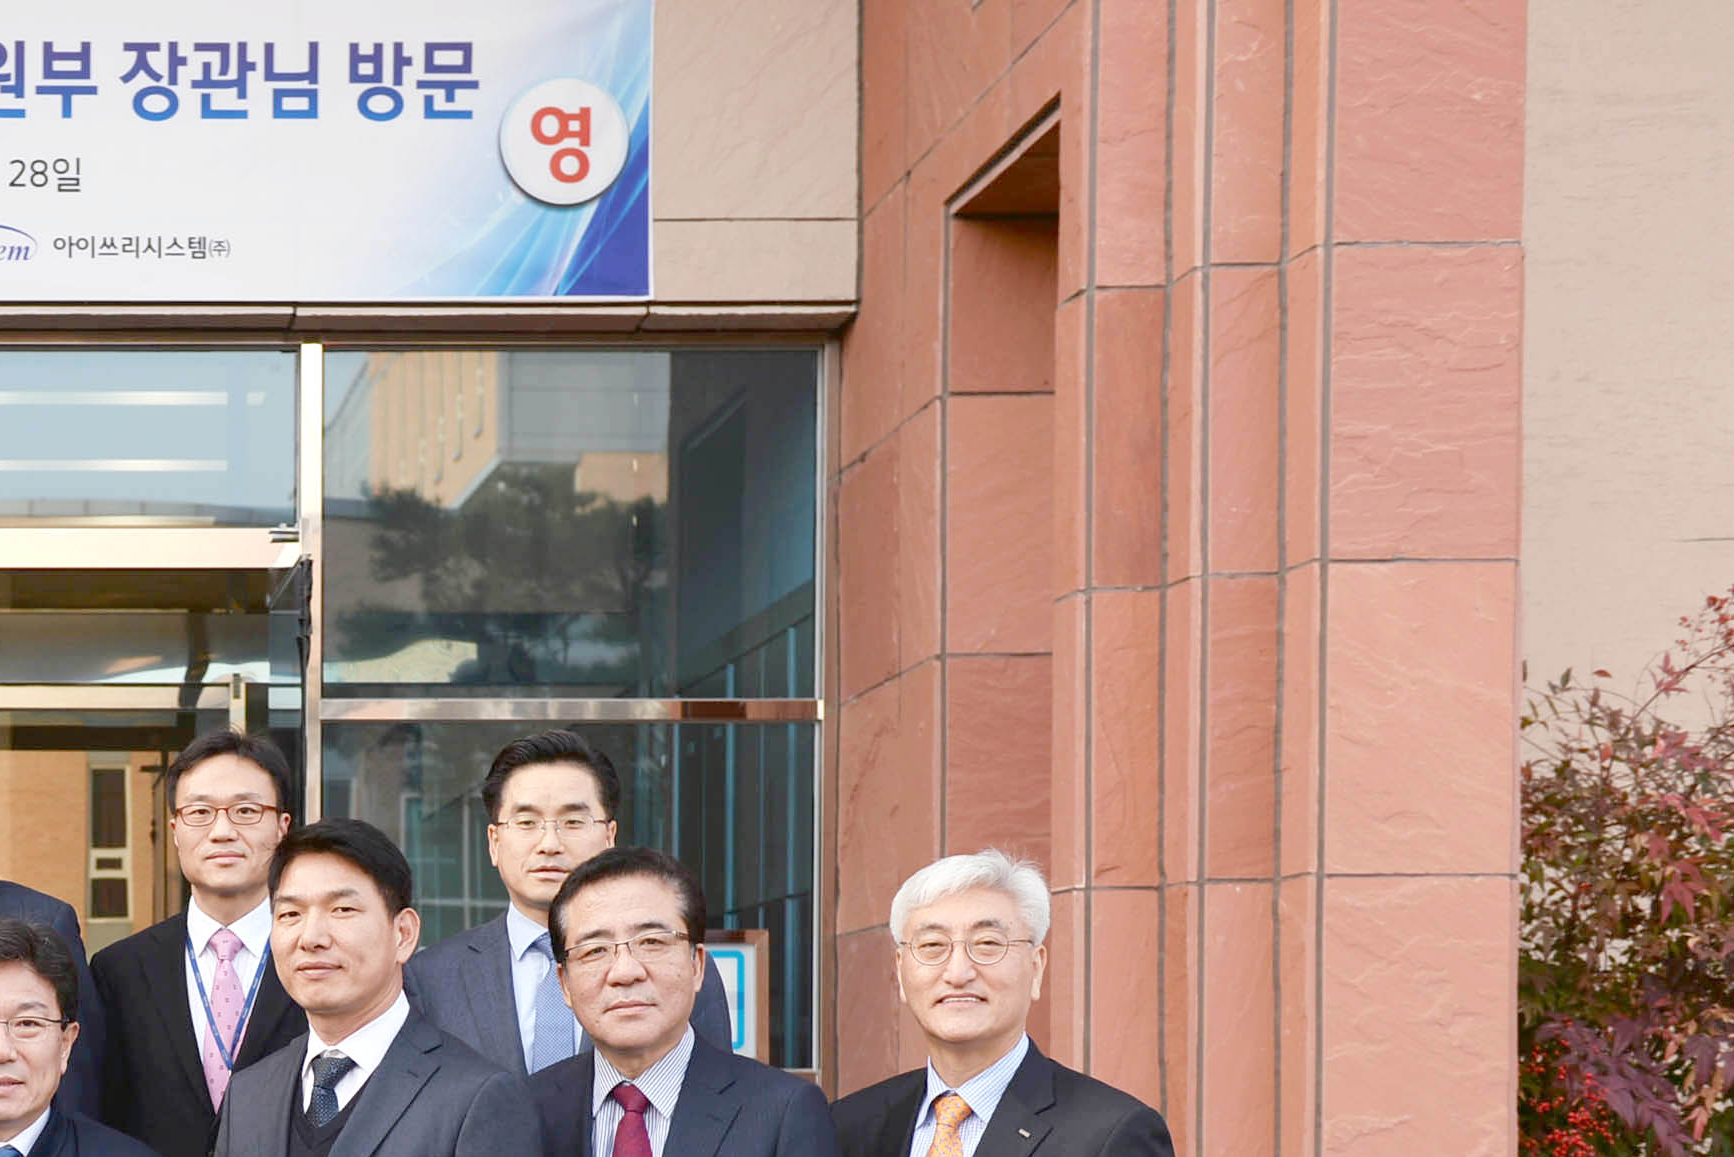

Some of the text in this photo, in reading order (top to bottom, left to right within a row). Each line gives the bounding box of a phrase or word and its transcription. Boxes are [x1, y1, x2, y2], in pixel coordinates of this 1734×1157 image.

[118, 40, 321, 122] 장관님
[347, 41, 481, 122] 방문
[8, 156, 83, 192] 28일
[530, 105, 592, 184] 영
